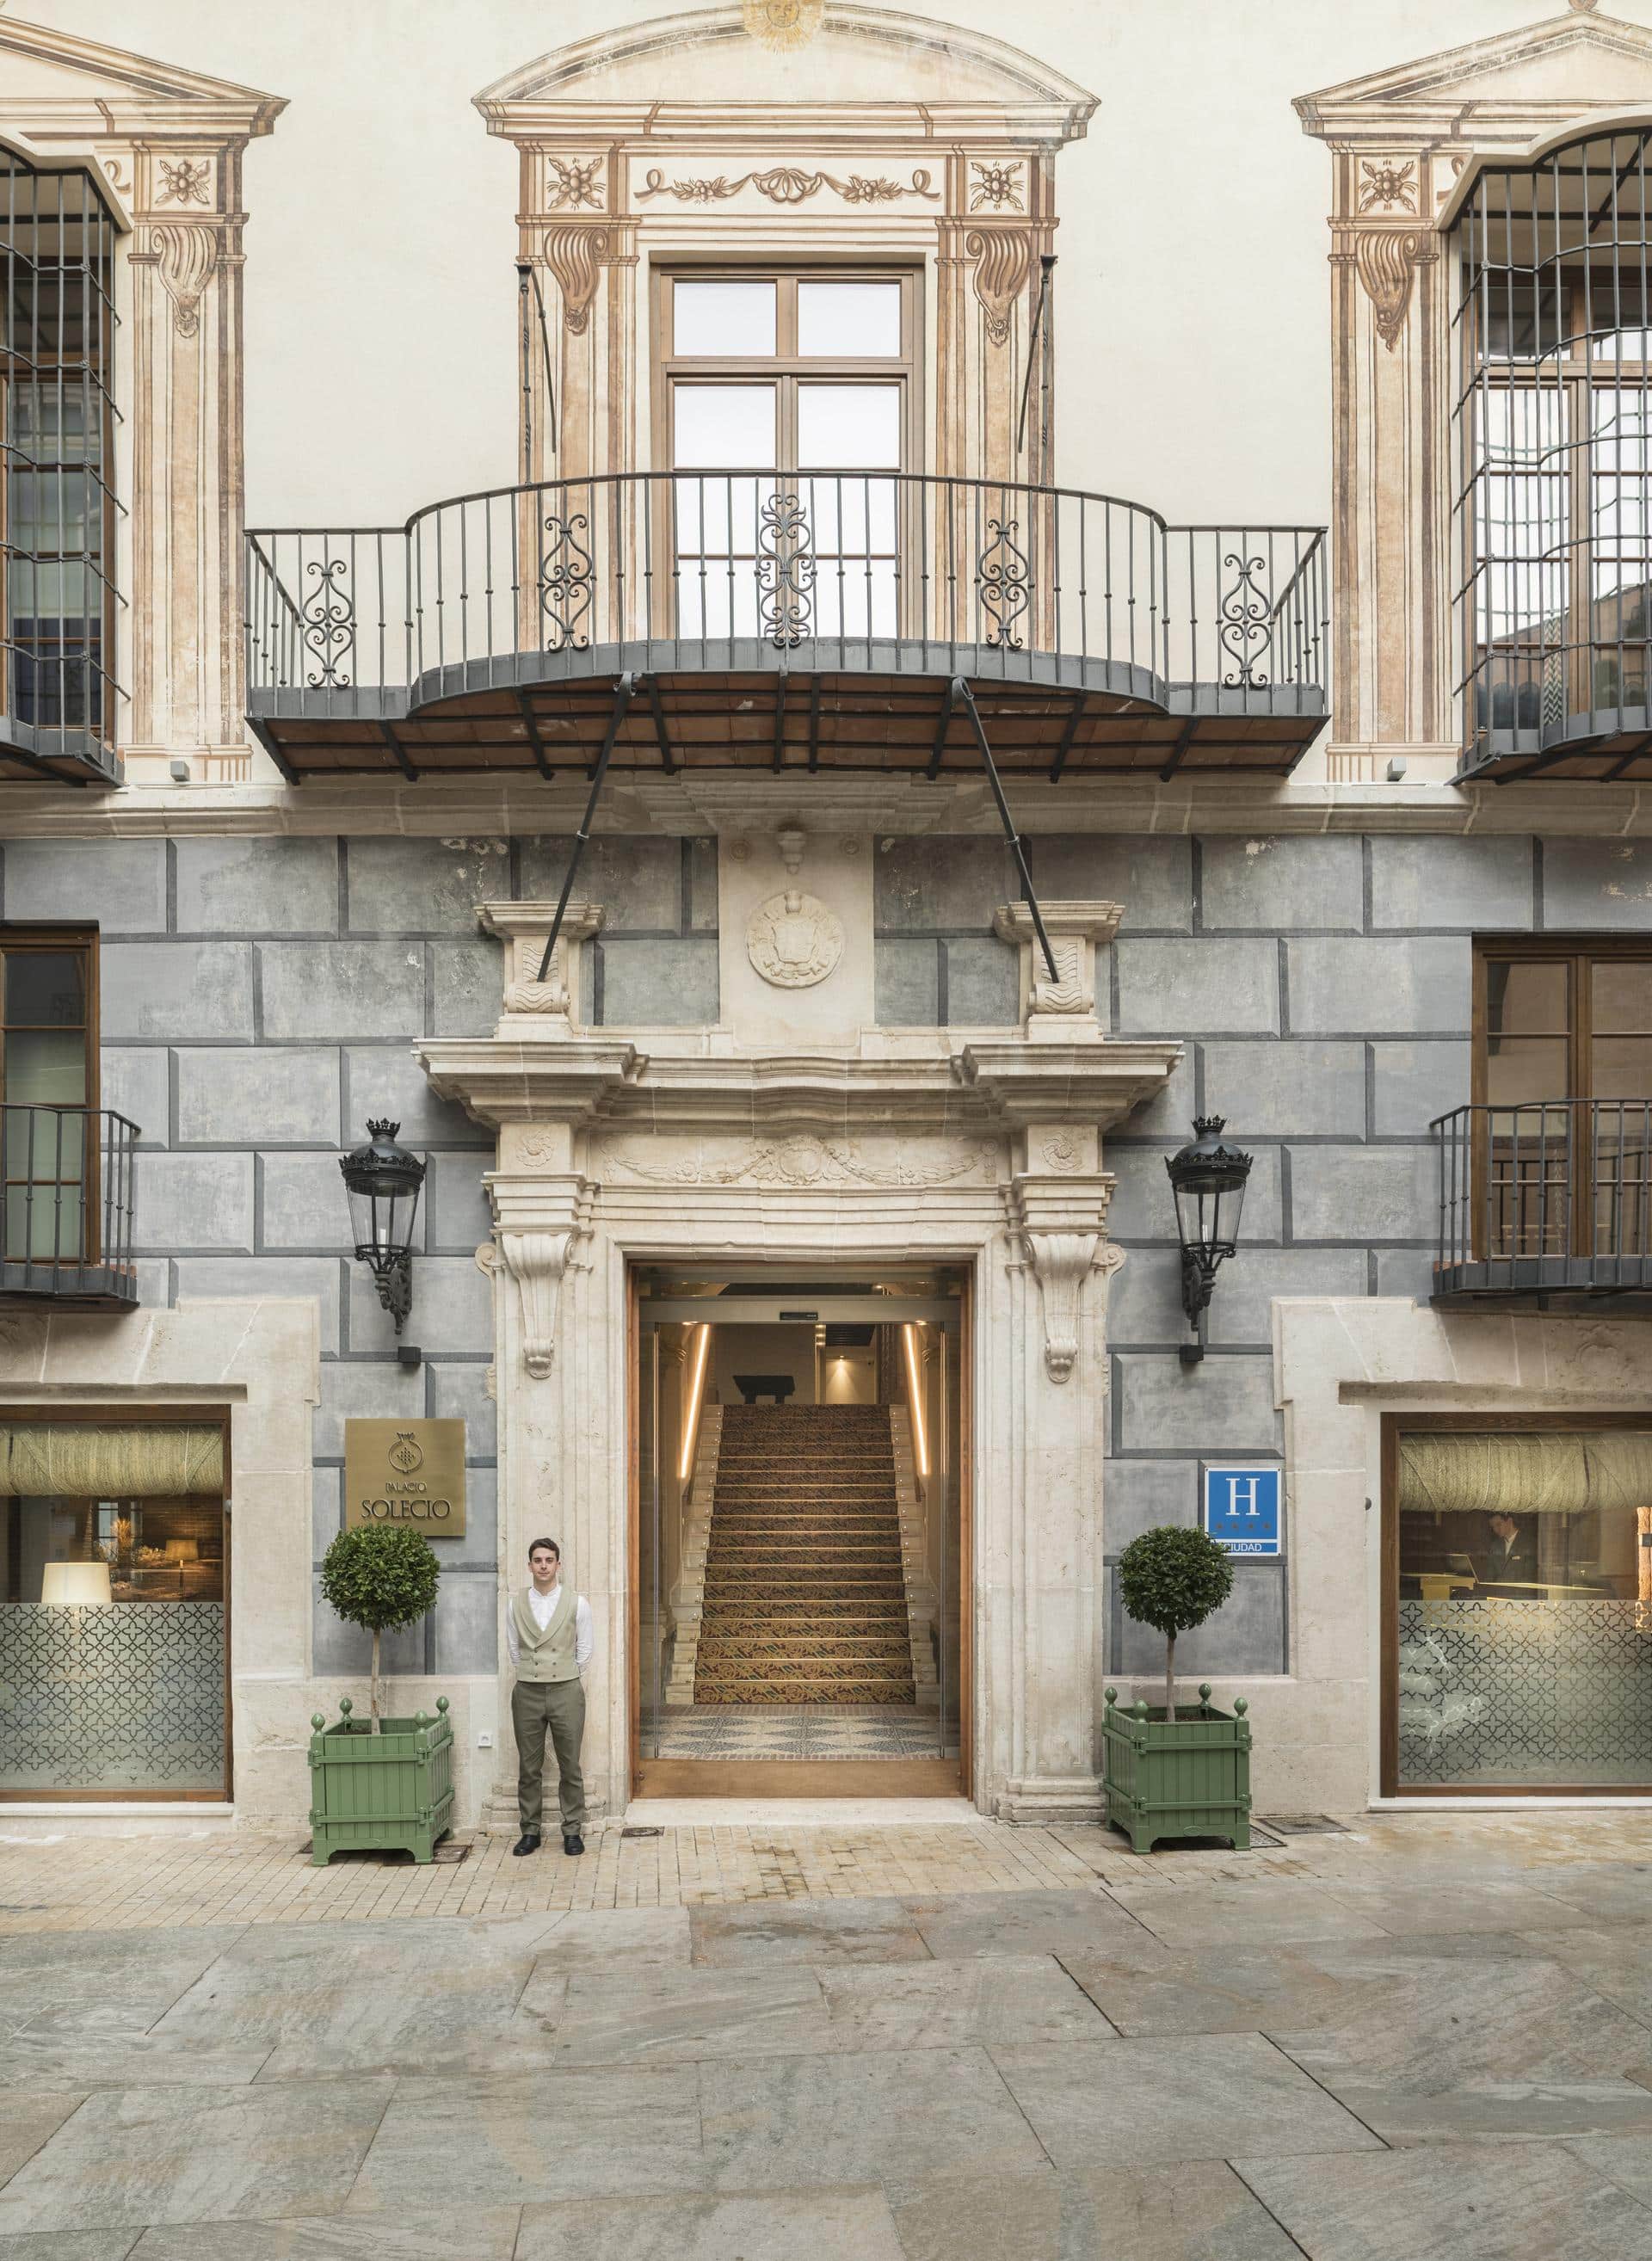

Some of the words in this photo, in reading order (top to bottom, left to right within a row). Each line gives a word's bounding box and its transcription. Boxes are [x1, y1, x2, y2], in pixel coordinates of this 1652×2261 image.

[385, 1481, 428, 1494] PALACIO
[1225, 1478, 1260, 1515] H
[361, 1499, 451, 1519] SOLECIO
[1224, 1543, 1262, 1552] CIUDAD
